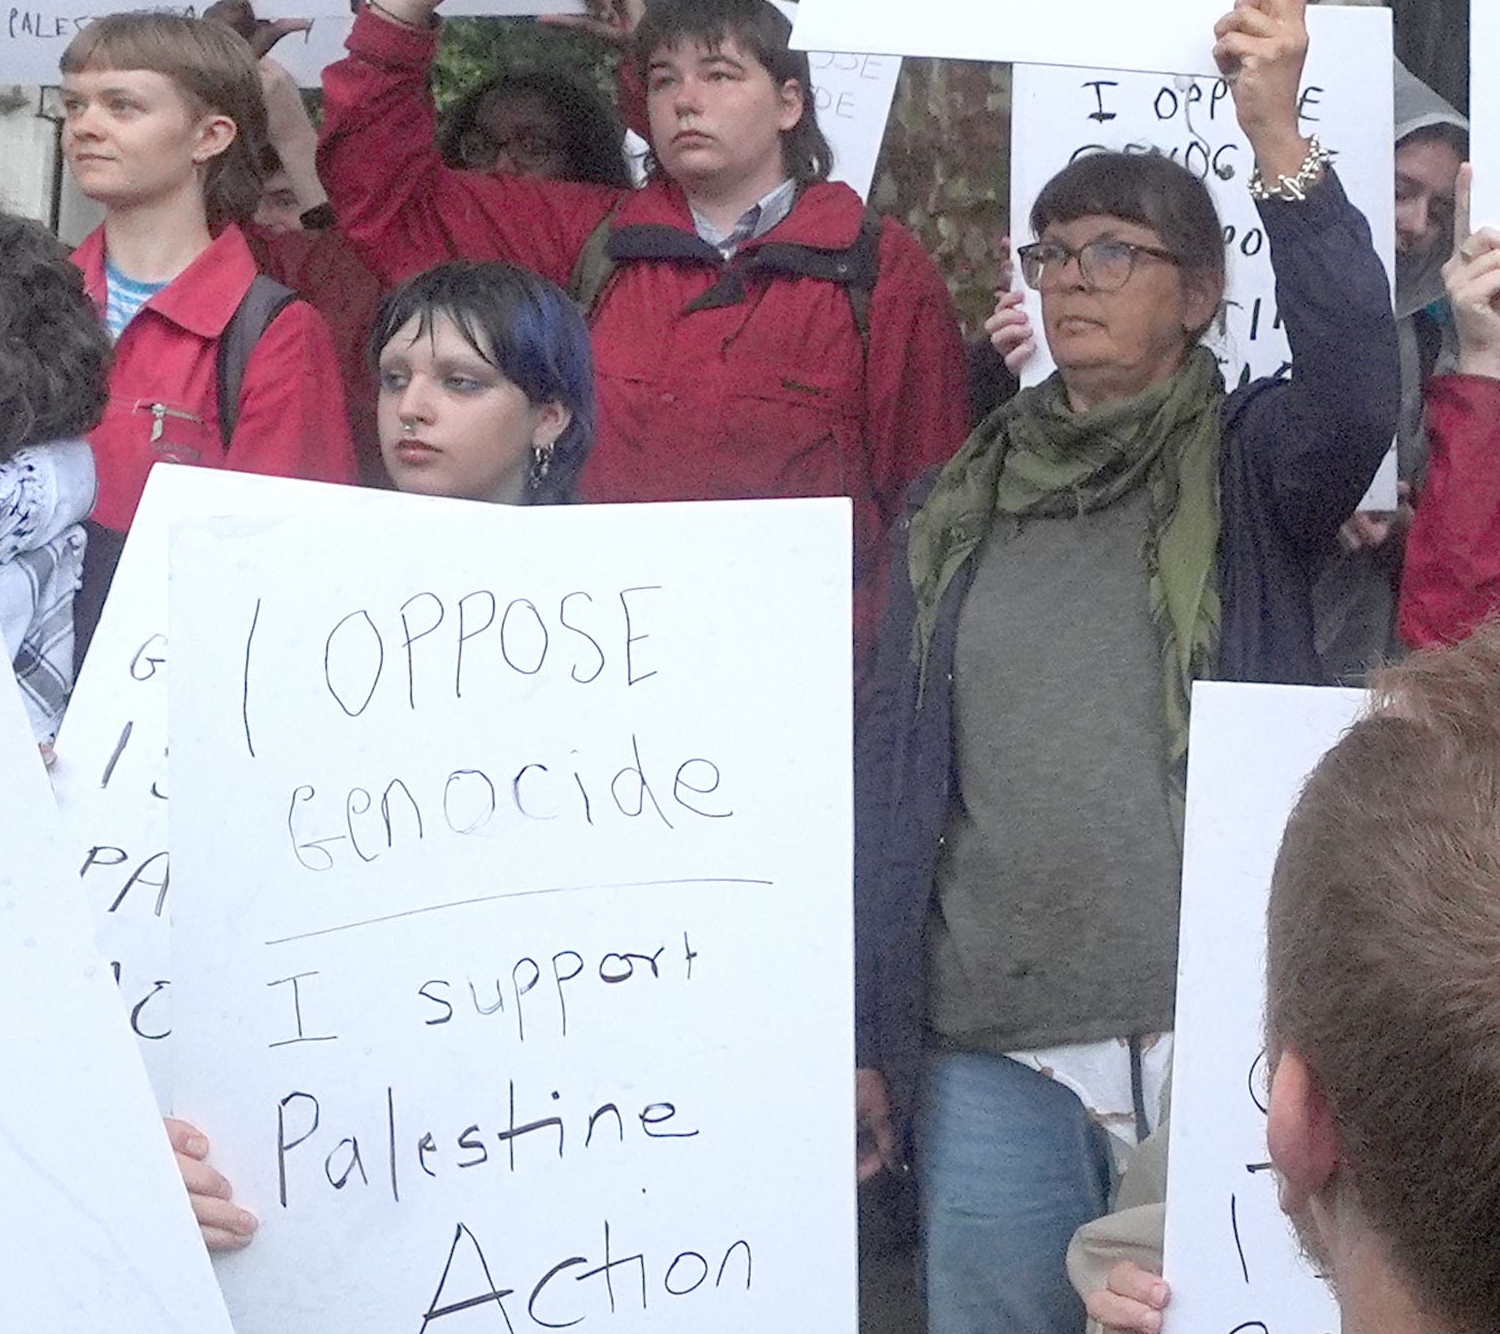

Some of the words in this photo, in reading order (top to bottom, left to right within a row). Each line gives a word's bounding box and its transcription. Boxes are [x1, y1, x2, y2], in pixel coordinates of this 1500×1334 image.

[1082, 82, 1118, 123] I
[1154, 78, 1323, 121] OPPE
[243, 597, 262, 757] I
[324, 585, 662, 717] OPPOSE
[268, 969, 339, 1047] I
[420, 932, 698, 1042] support
[276, 1081, 699, 1208] Palestine
